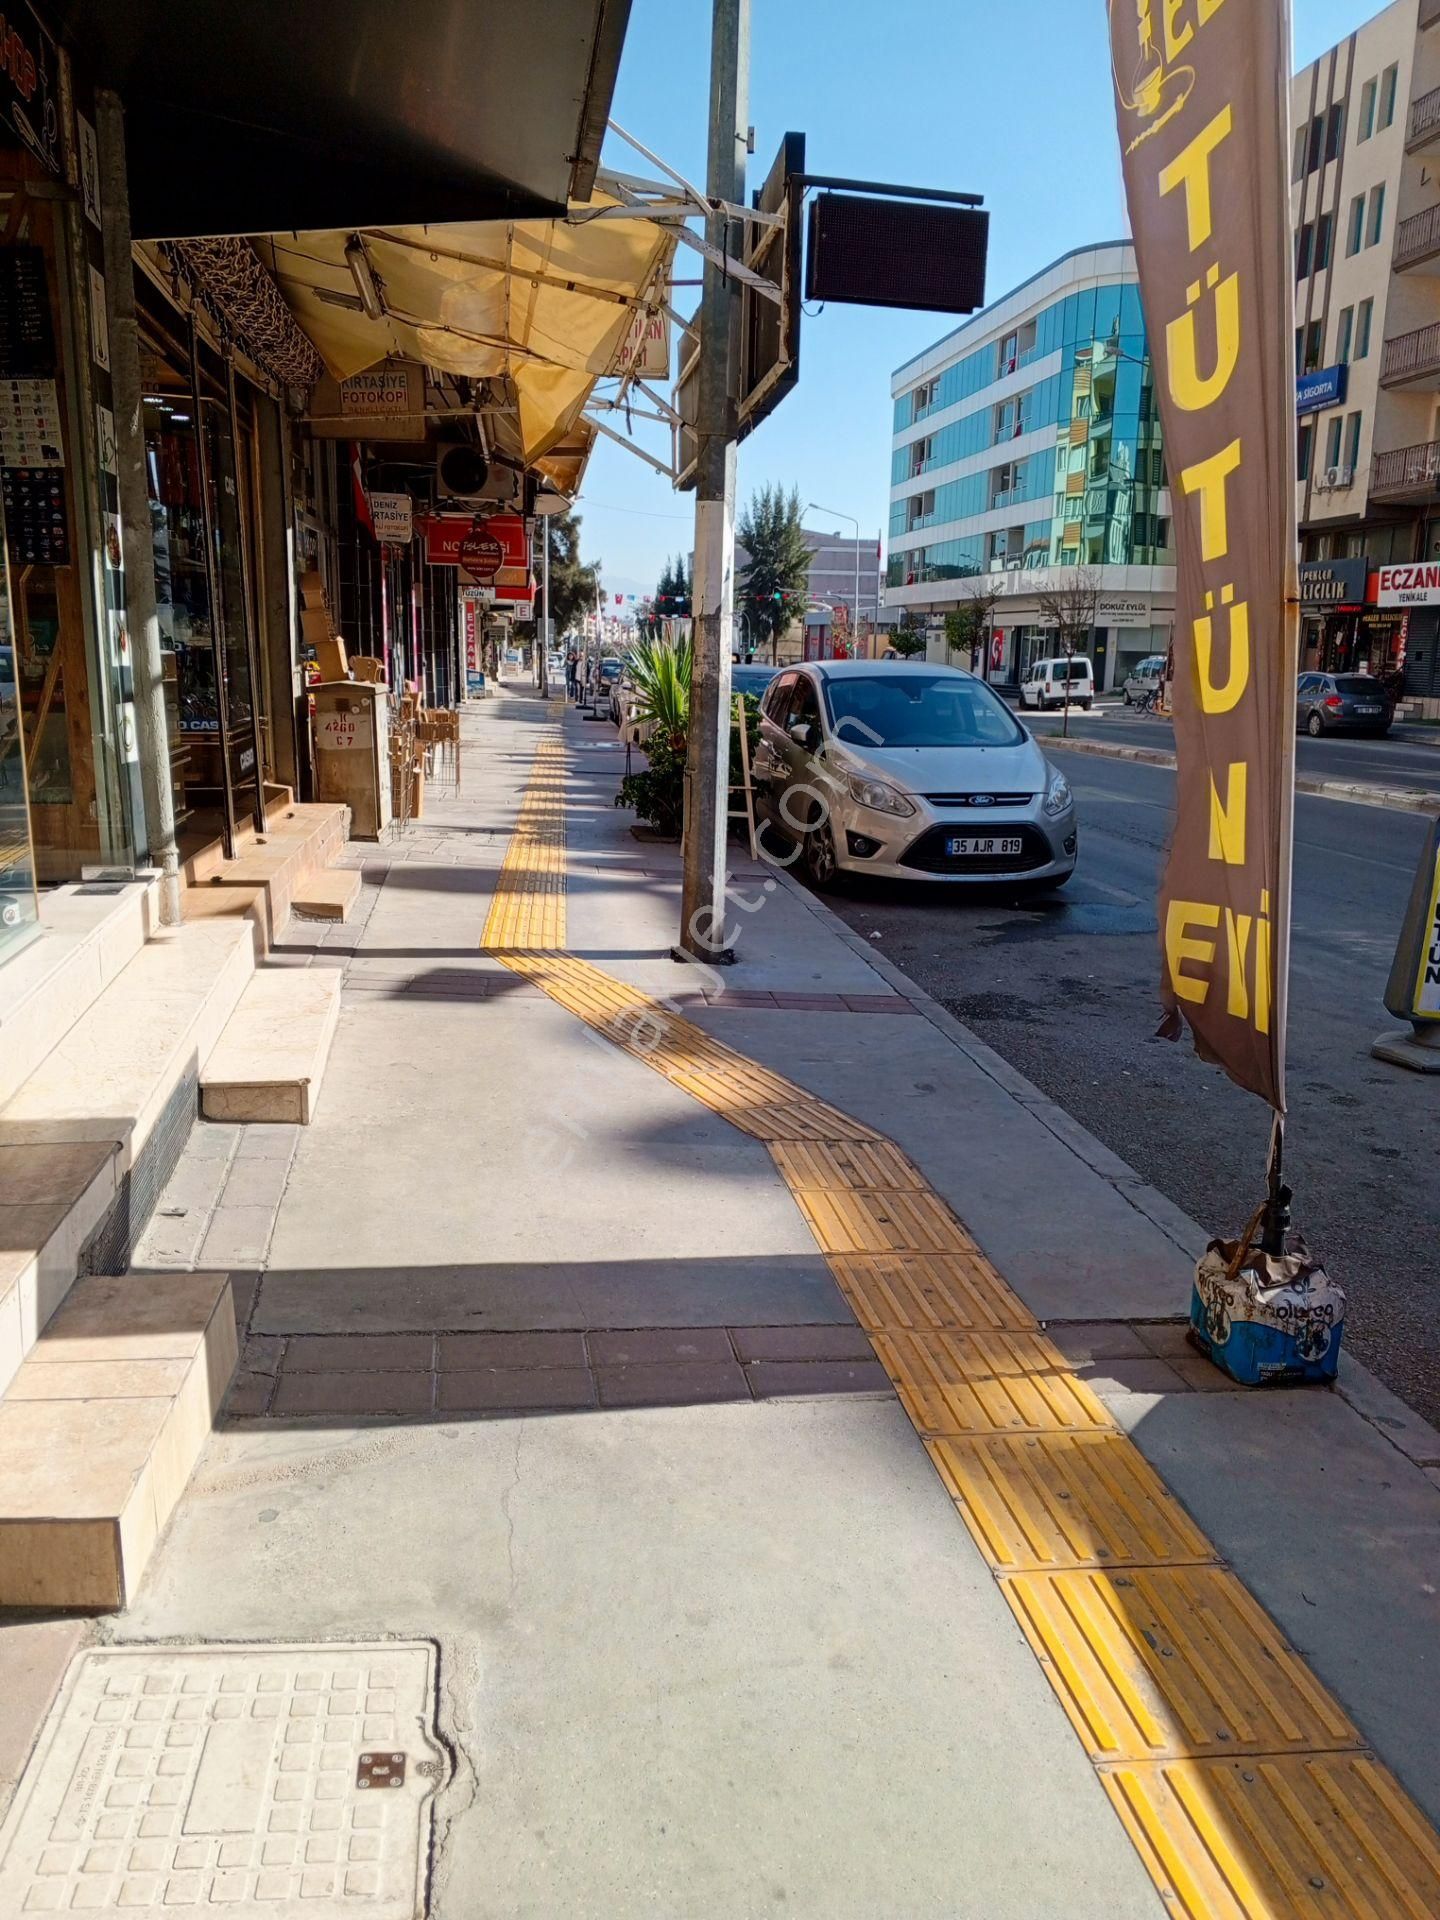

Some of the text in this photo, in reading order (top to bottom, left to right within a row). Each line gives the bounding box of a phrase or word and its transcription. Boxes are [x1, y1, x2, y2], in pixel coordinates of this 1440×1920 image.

[342, 390, 407, 403] FOTOKOPİ
[1303, 381, 1333, 400] SİGORTA
[1159, 103, 1249, 865] TÜTÜN
[373, 500, 398, 509] DENİZ
[373, 510, 409, 521] RTASİYE
[1380, 566, 1440, 591] ECZAN
[1303, 582, 1345, 600] LICILIK
[1398, 591, 1428, 603] YENİKALE
[1100, 602, 1147, 611] DOKUZ EYLÜL
[953, 840, 1020, 853] 35 AJR 819
